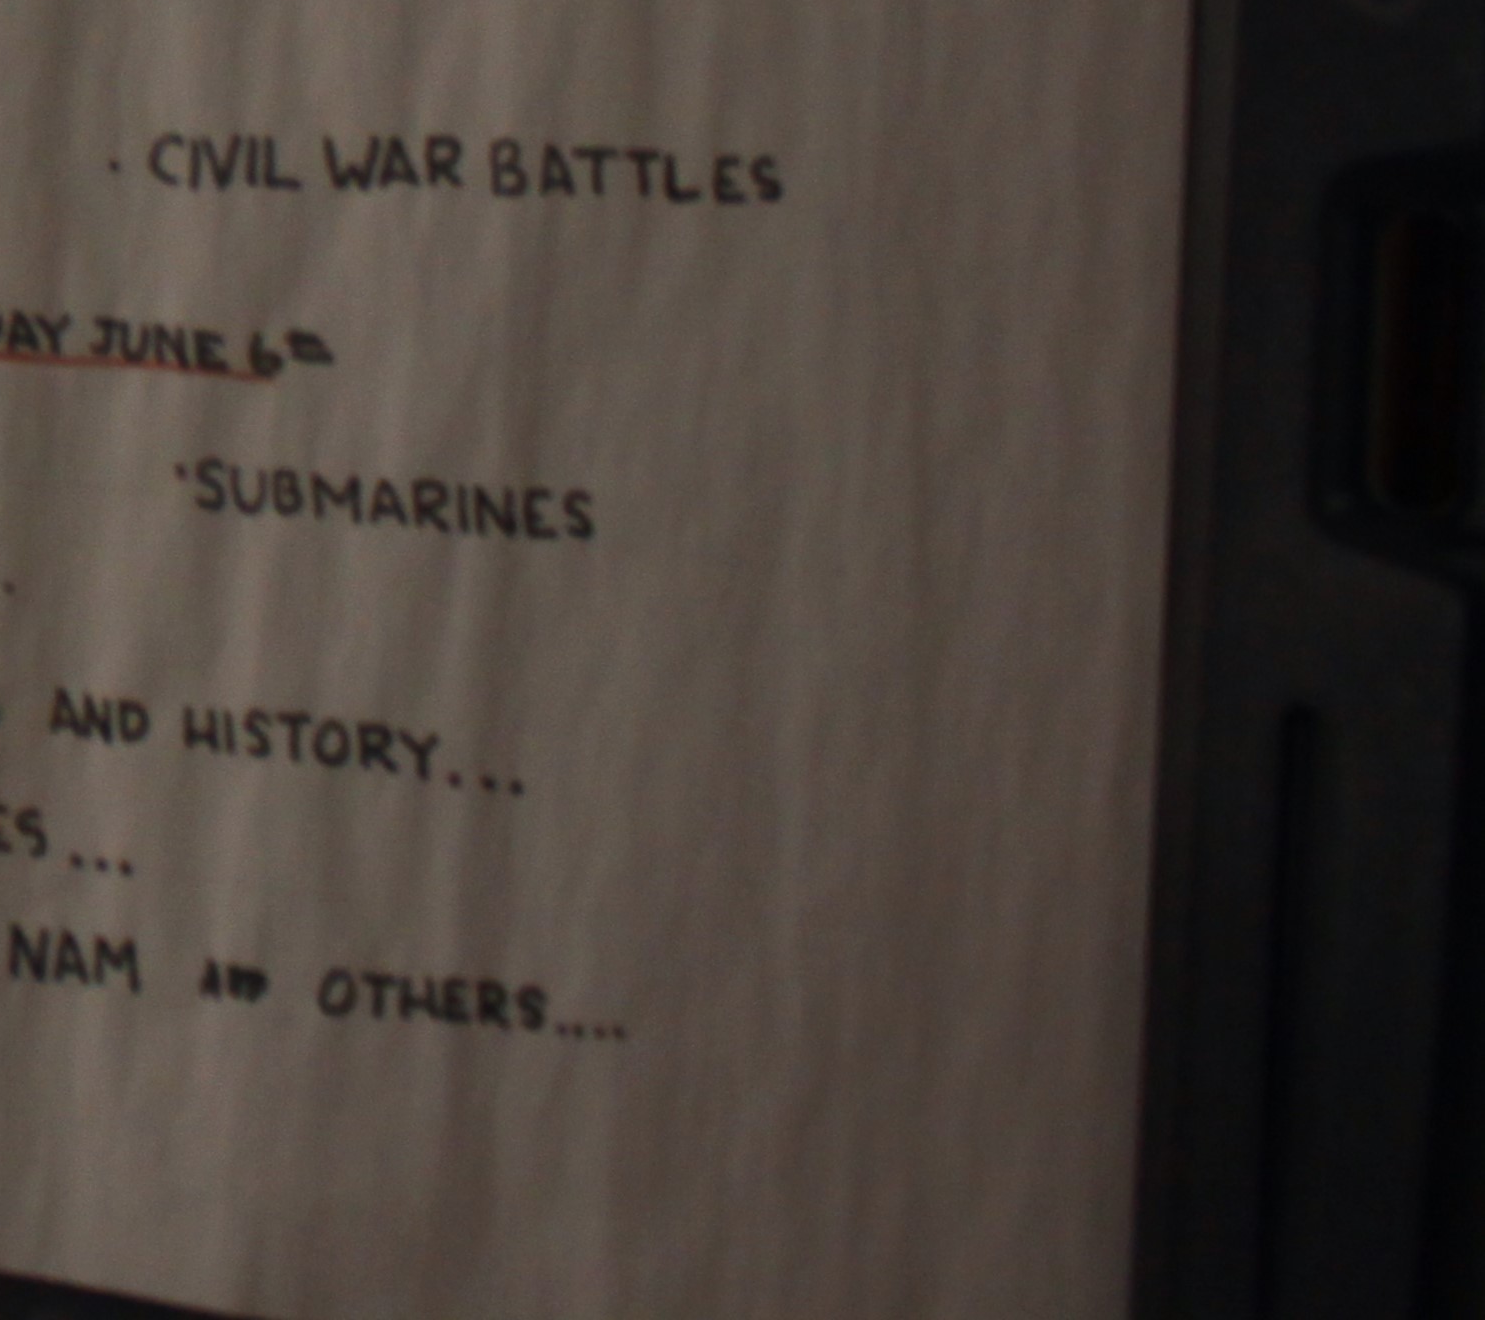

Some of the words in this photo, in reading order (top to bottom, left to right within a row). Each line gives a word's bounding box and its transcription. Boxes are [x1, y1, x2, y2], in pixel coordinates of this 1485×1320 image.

[150, 131, 303, 192] CIVIL
[324, 131, 463, 192] WAR
[489, 137, 785, 205] BATTLES
[91, 315, 229, 375] JUNE
[194, 454, 597, 541] SUBMARINES
[48, 686, 151, 748] AND
[9, 920, 142, 995] NAM
